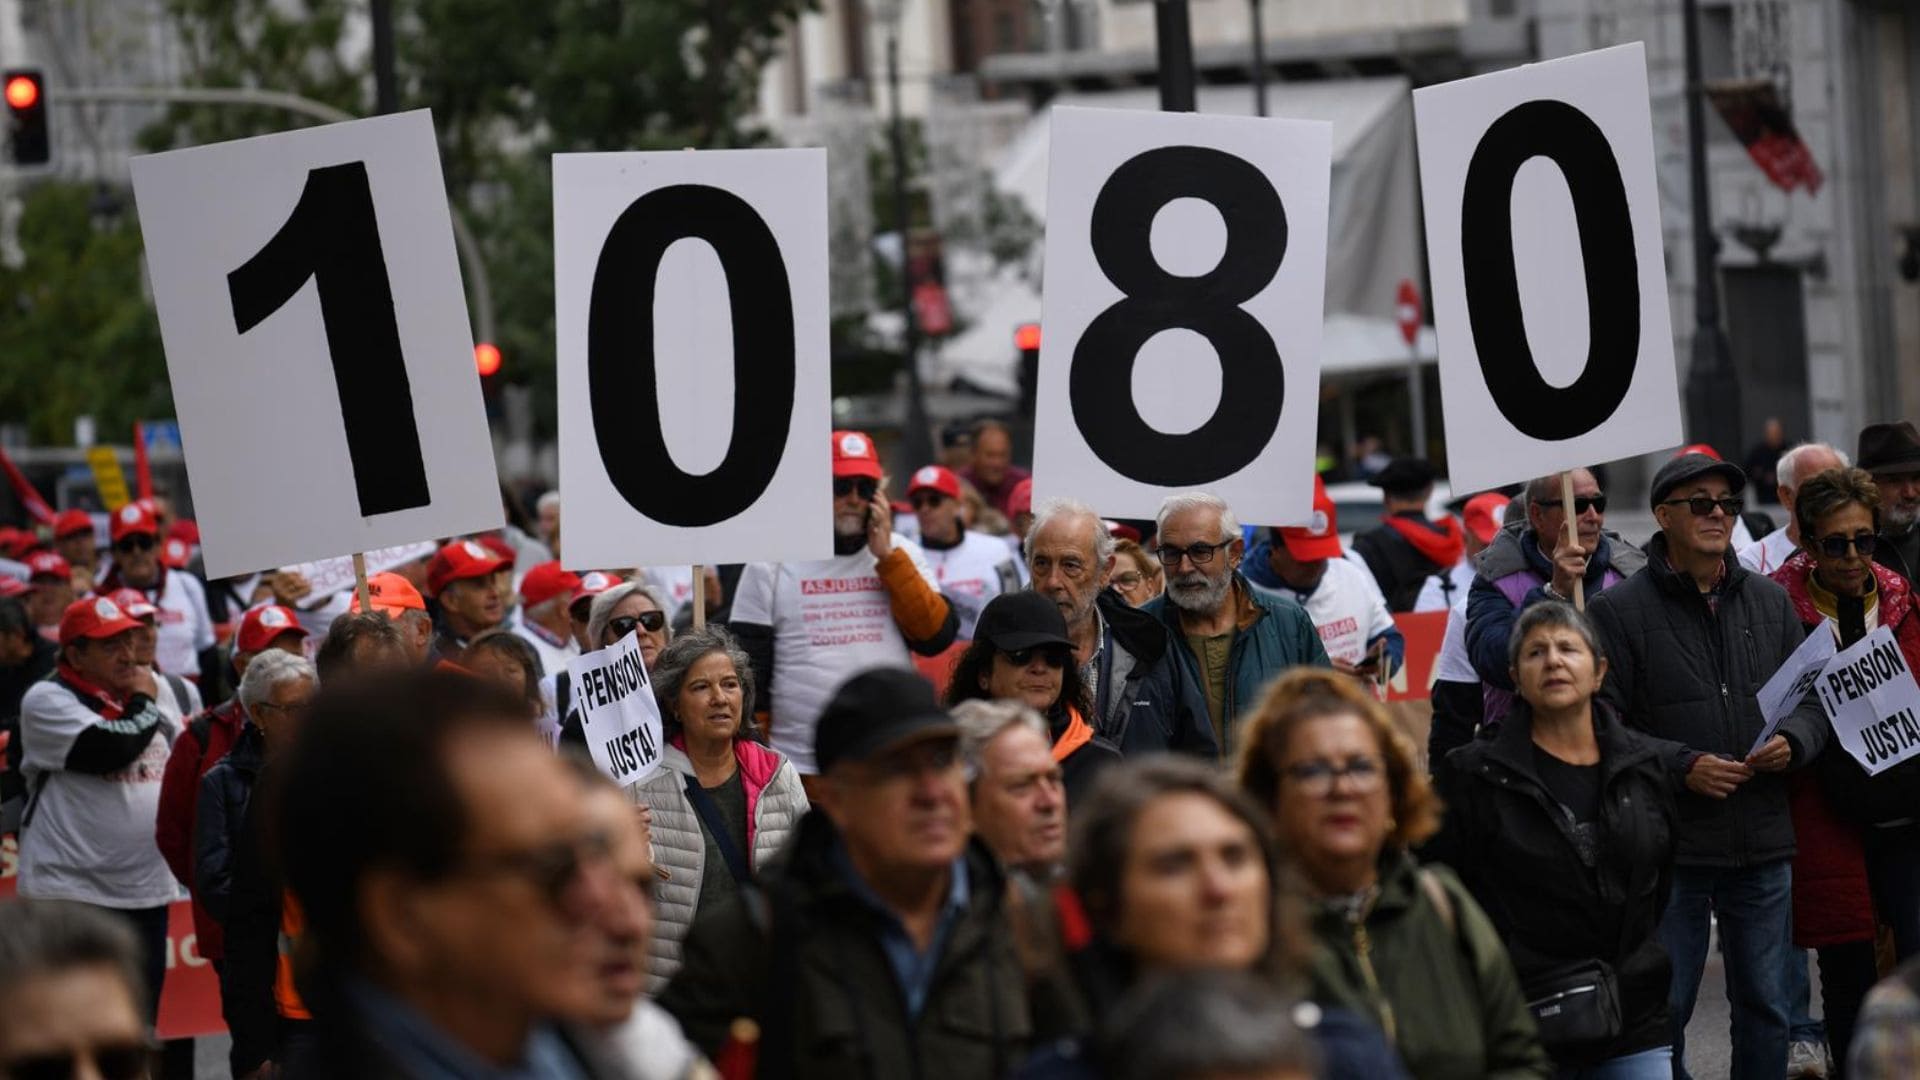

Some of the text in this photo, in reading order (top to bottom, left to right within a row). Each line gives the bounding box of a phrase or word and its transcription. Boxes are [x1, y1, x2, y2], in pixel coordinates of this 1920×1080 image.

[227, 161, 431, 517] 1
[588, 185, 795, 527] 0
[1070, 146, 1287, 487] 8
[1462, 100, 1640, 441] 0
[606, 722, 657, 780] JUSTA!
[1860, 707, 1920, 765] JUSTA!
